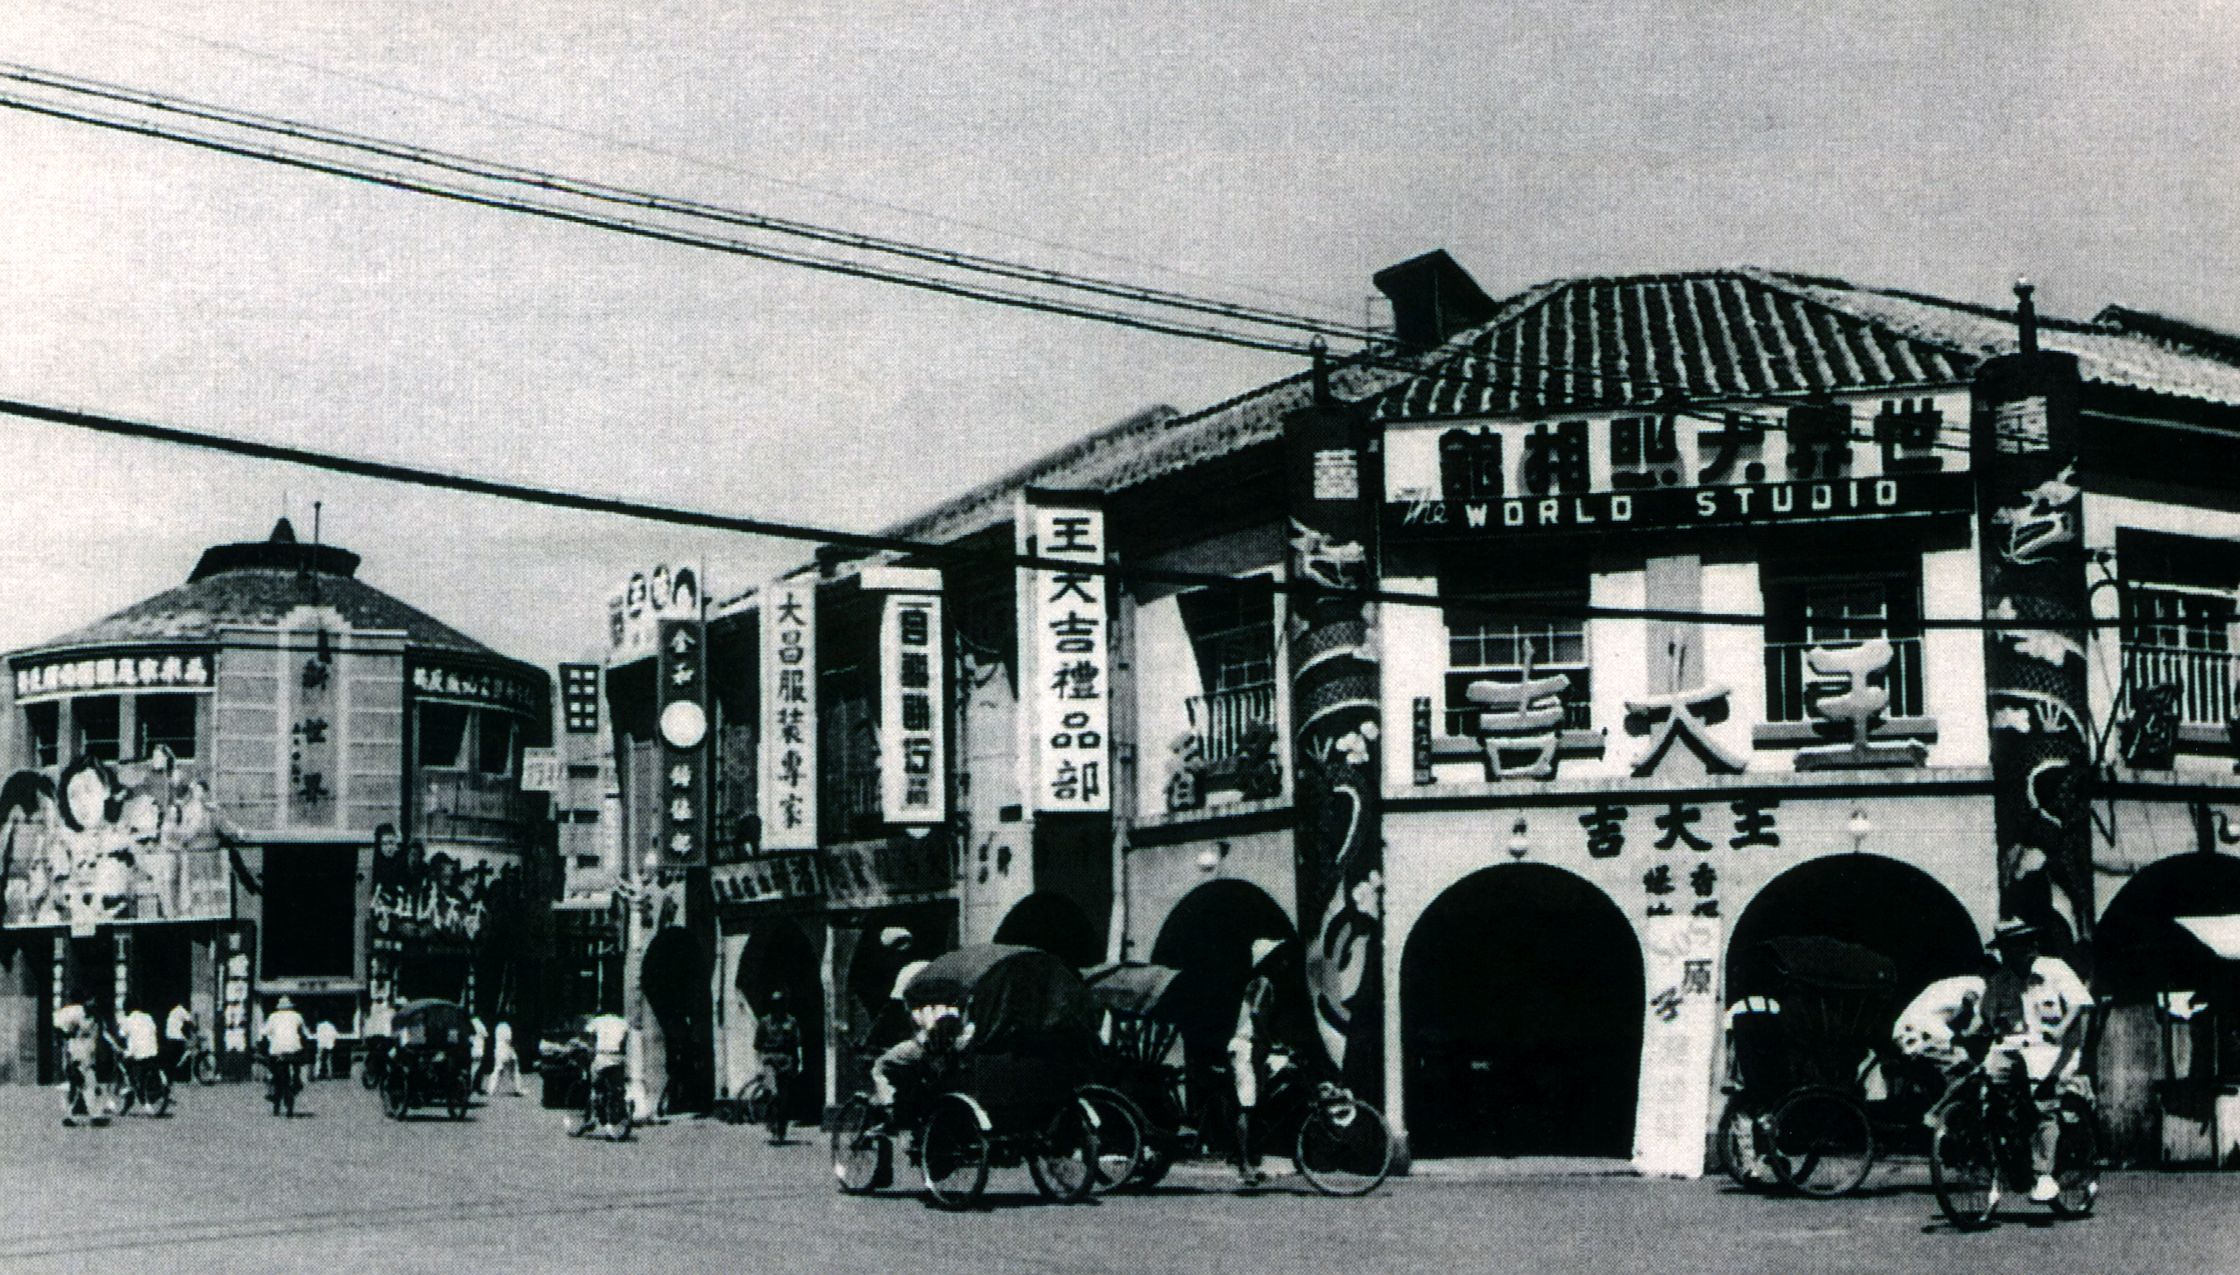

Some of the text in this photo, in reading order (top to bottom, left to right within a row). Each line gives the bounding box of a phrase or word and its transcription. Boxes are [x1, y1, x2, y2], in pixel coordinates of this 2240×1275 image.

[1466, 495, 1632, 528] WORLD
[1696, 480, 1898, 517] STUDIO
[1046, 516, 1101, 802] 王大吉禮品部
[1465, 637, 1928, 779] 王大吉
[1578, 800, 1781, 859] 王大吉
